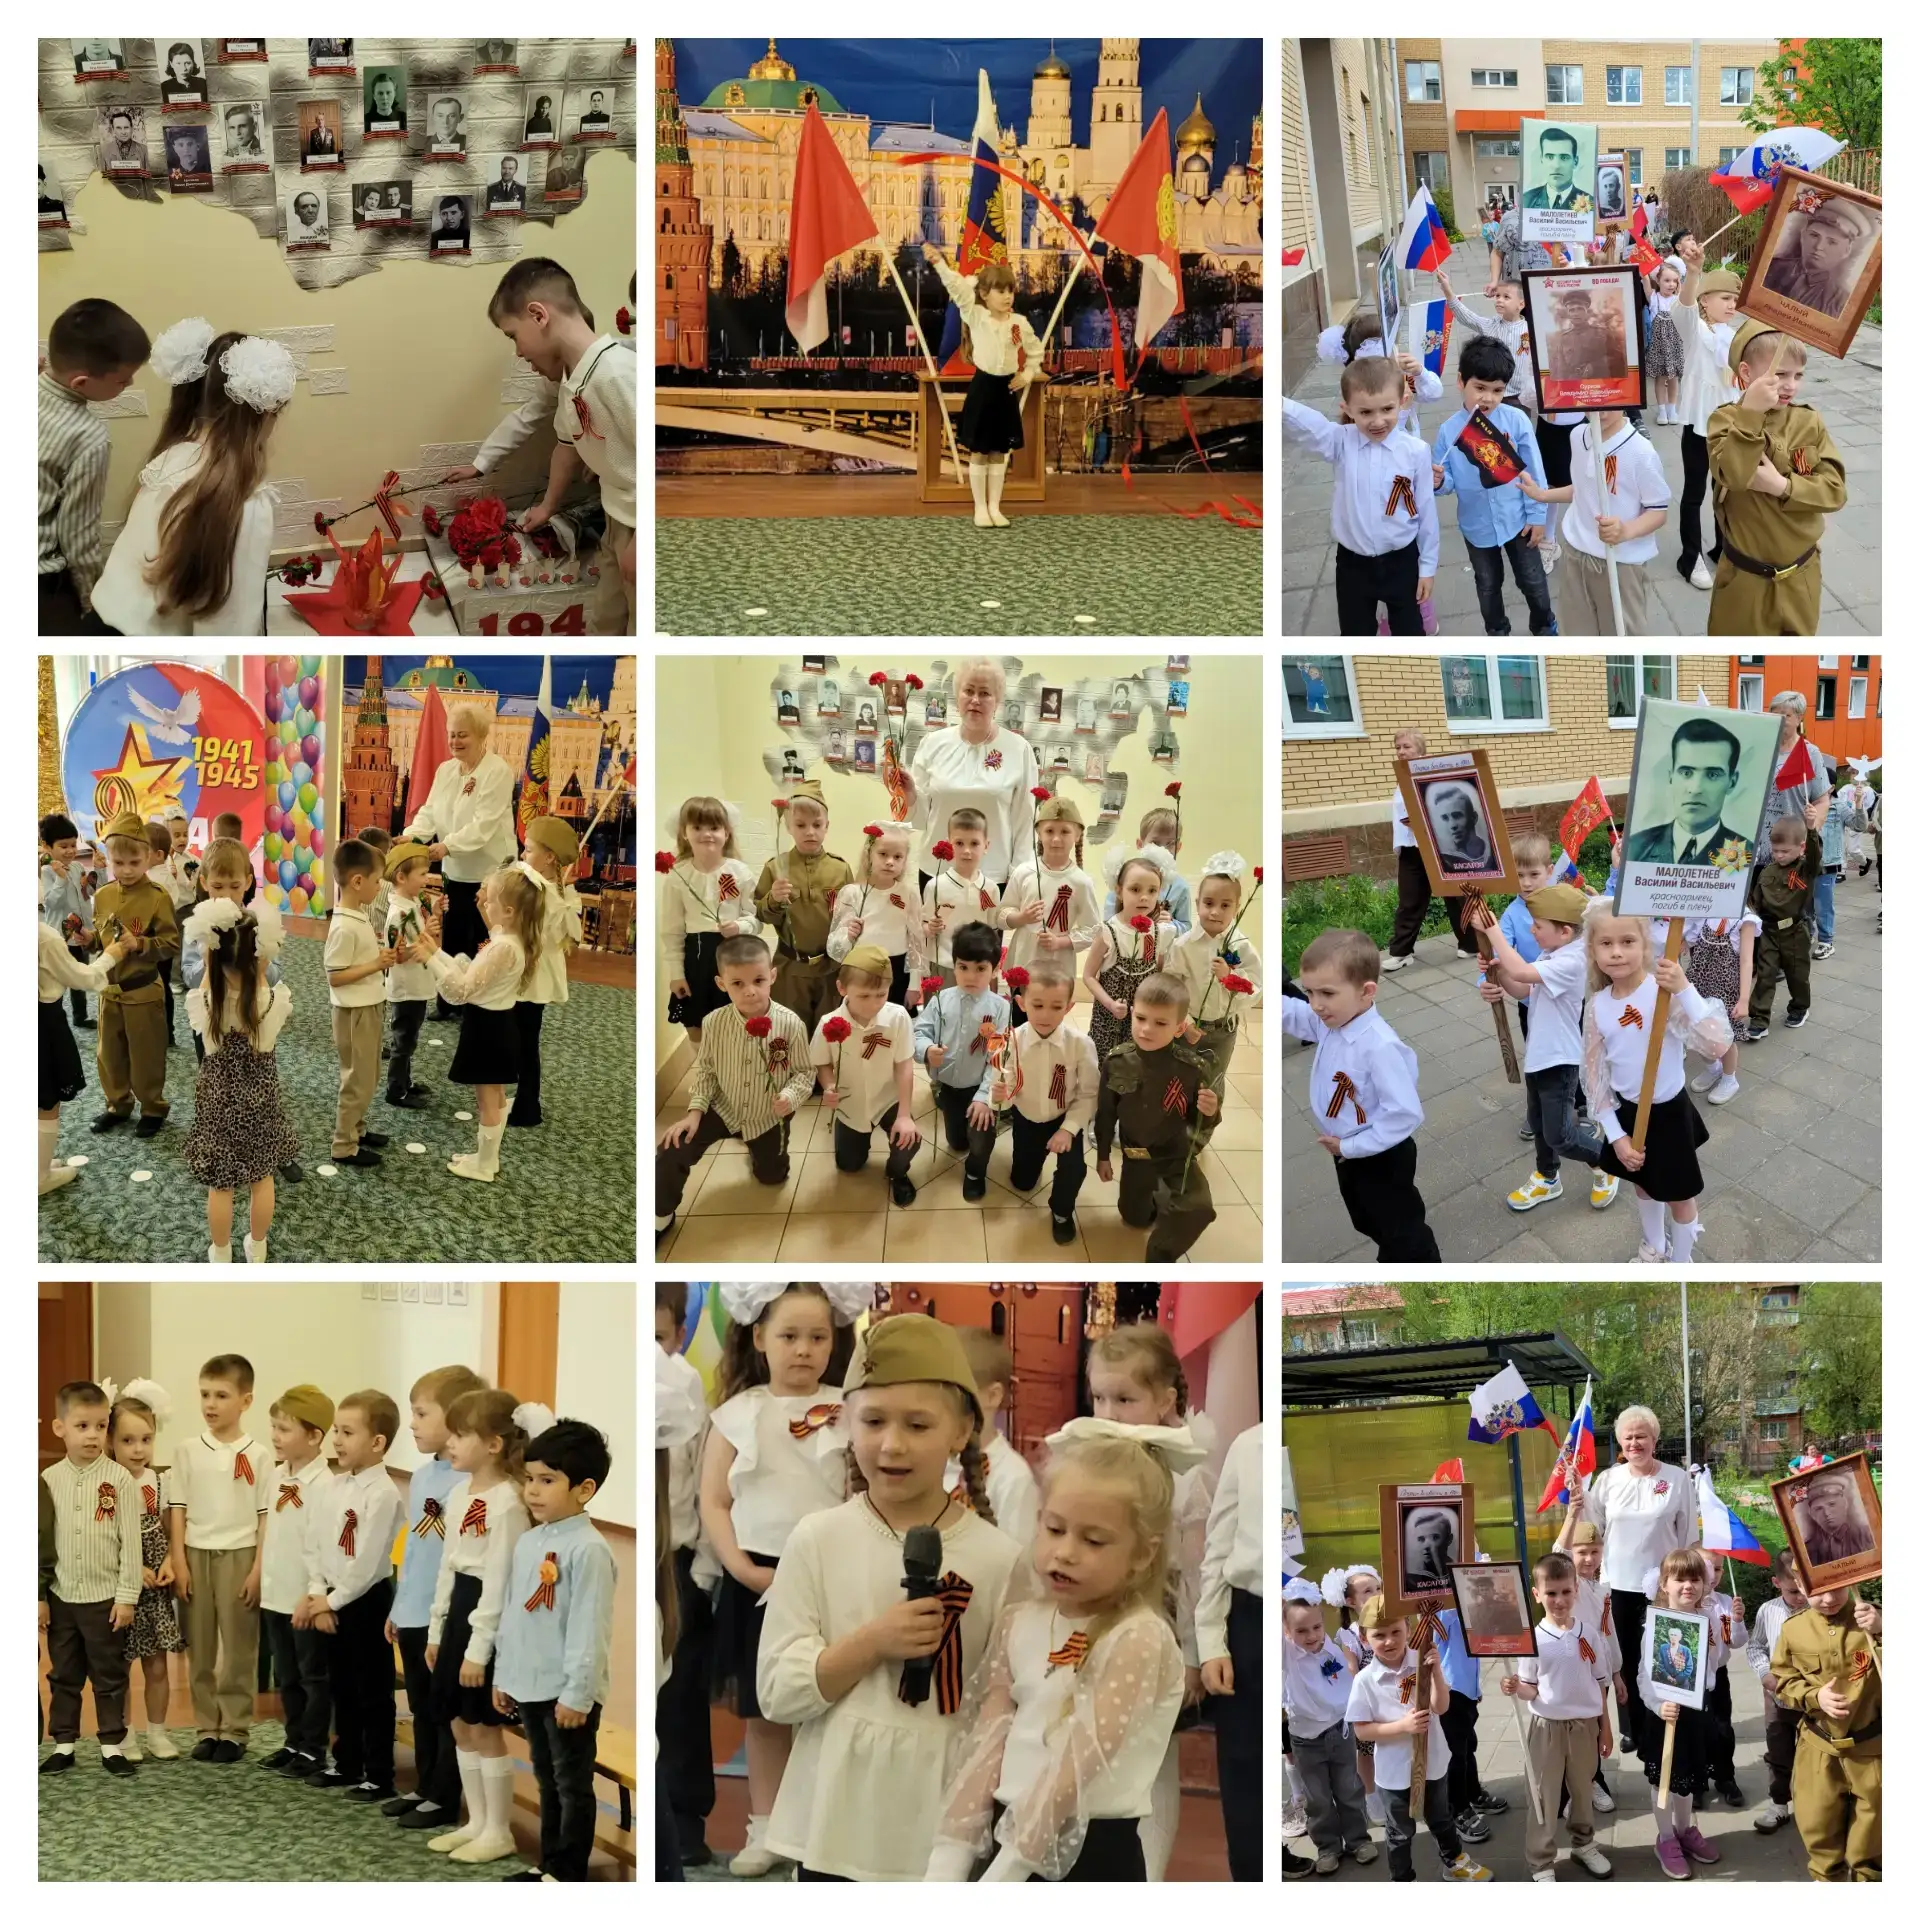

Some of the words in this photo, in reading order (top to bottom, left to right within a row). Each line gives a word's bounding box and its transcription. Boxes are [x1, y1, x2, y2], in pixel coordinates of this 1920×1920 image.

[1780, 300, 1809, 318] ЧАЛЫЙ
[191, 736, 253, 765] 1941
[194, 762, 261, 790] 1945
[1656, 867, 1720, 879] МАЛОЛЕТНЕВ
[1635, 876, 1678, 887] Василий
[1680, 879, 1736, 890] Васильевич
[1650, 892, 1714, 903] красноармеец,
[1652, 902, 1679, 910] погиб
[1687, 904, 1712, 912] плену
